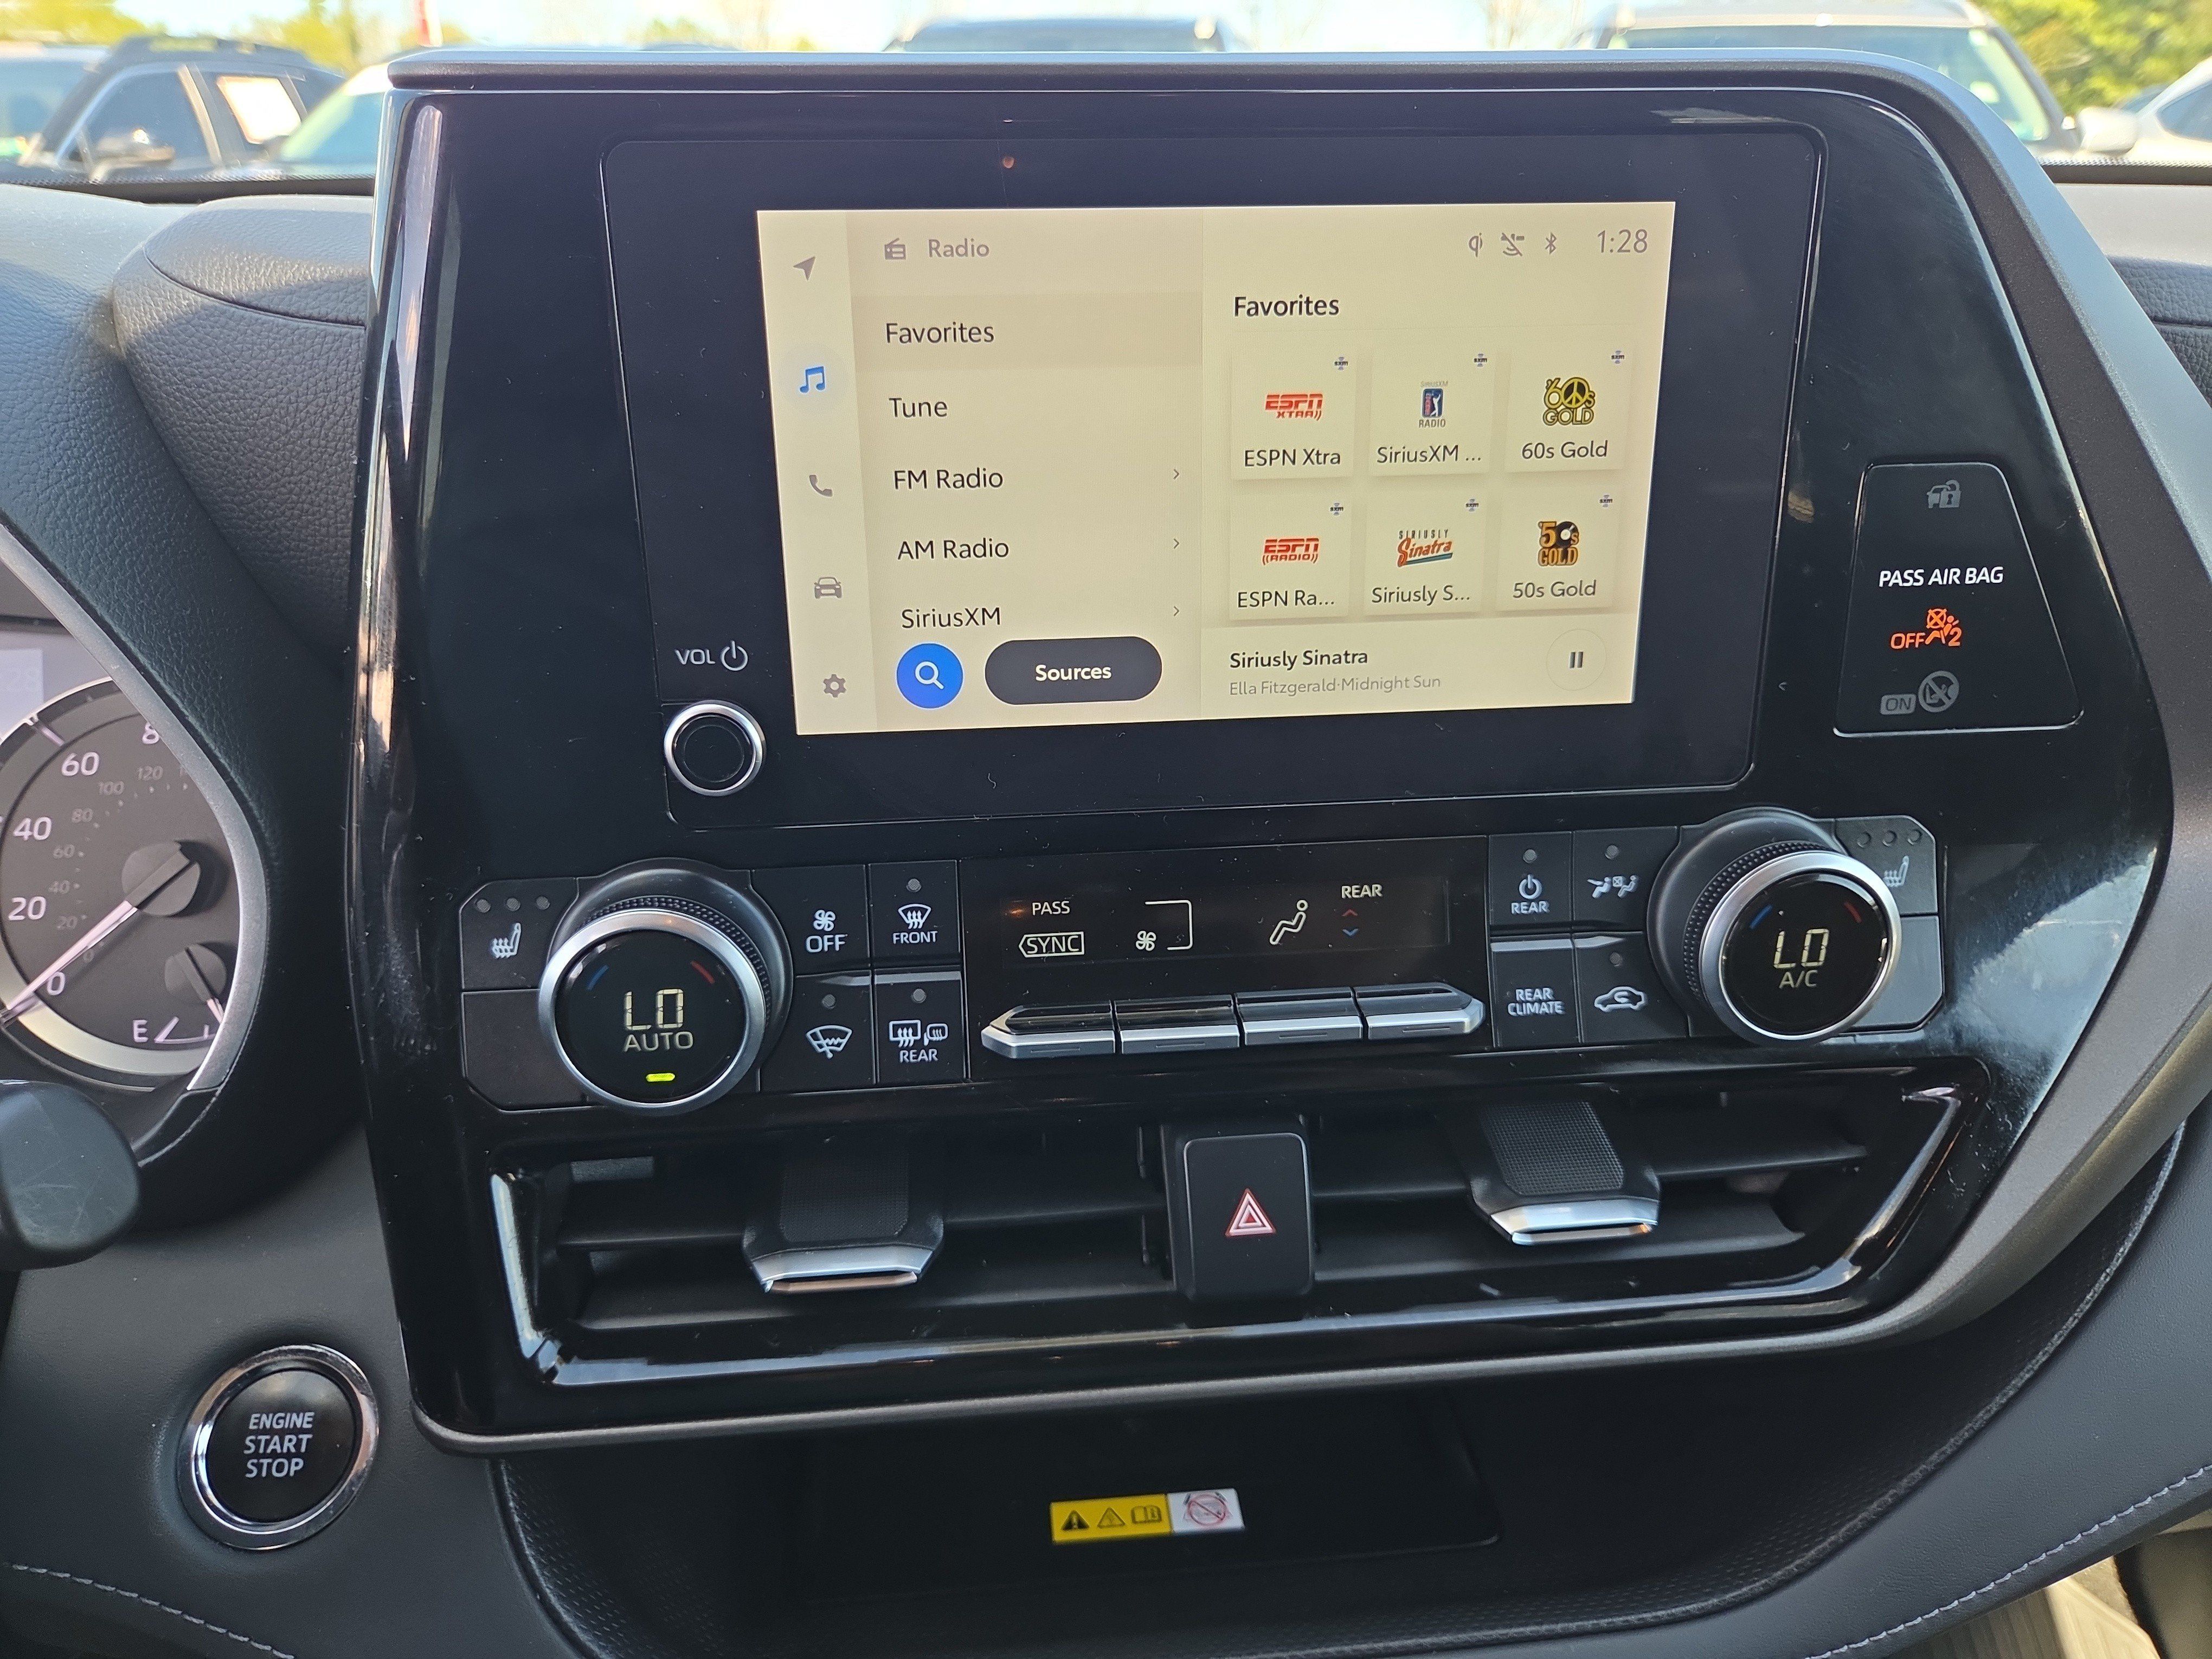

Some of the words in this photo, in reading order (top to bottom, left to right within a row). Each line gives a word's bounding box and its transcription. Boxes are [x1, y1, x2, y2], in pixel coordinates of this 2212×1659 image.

[928, 239, 990, 258] Radio
[1597, 229, 1648, 253] 1:28
[1234, 294, 1339, 317] Favorites
[886, 321, 994, 344] Favorites
[890, 397, 948, 418] Tune
[1265, 394, 1323, 411] ESPN
[1418, 419, 1446, 428] RADIO
[1542, 407, 1594, 426] GOLD
[1244, 449, 1296, 467] ESPN
[1302, 448, 1341, 466] Xtra
[1377, 445, 1459, 464] SiriusXM
[1522, 442, 1554, 459] 60s
[1561, 440, 1608, 458] Gold
[894, 470, 928, 490] FM
[936, 467, 1004, 489] Radio
[1399, 529, 1448, 539] SIRIUSLY
[897, 541, 935, 560] AM
[943, 537, 1009, 559] Radio
[1264, 538, 1320, 554] ESPN
[1397, 537, 1453, 567] Sinatra
[1538, 546, 1578, 566] GOLD
[1879, 569, 1924, 587] PASS
[1928, 568, 1960, 585] AIR
[1964, 566, 2004, 584] BAG
[1238, 590, 1288, 608] ESPN
[1295, 589, 1334, 607] Ra...
[1371, 586, 1438, 606] Siriusly
[1442, 585, 1470, 602] S...
[1513, 582, 1545, 598] 50s
[1550, 580, 1597, 597] Gold
[902, 607, 1001, 629] SiriusXM
[1891, 632, 1926, 649] OFF
[676, 650, 715, 665] VOL
[1230, 651, 1297, 671] Siriusly
[1302, 650, 1368, 665] Sinatra
[1036, 664, 1112, 681] Sources
[1230, 681, 1257, 695] Ella
[1413, 676, 1441, 689] Sun
[1885, 697, 1912, 712] ON
[61, 751, 100, 776] 60
[137, 765, 163, 780] 120
[98, 781, 125, 795] 100
[72, 808, 94, 822] 80
[13, 816, 53, 841] 40
[53, 844, 75, 858] 60
[48, 880, 70, 893] 40
[1341, 884, 1382, 899] REAR
[8, 896, 47, 921] 20
[1032, 900, 1070, 916] PASS
[1511, 902, 1548, 915] REAR
[56, 915, 79, 929] 20
[806, 934, 846, 953] OFF
[893, 930, 938, 944] FRONT
[1026, 934, 1082, 954] SYNC
[83, 950, 94, 962] 0
[1773, 928, 1829, 969] LO
[46, 972, 66, 995] 0
[1779, 970, 1818, 989] A/C
[1516, 987, 1554, 1002] REAR
[625, 988, 685, 1031] LO
[1508, 1000, 1565, 1016] CLIMATE
[133, 1019, 148, 1043] E
[623, 1031, 693, 1053] AUTO
[899, 1048, 938, 1063] REAR
[248, 1412, 315, 1430] ENGINE
[243, 1434, 313, 1454] START
[245, 1458, 304, 1478] STOP
